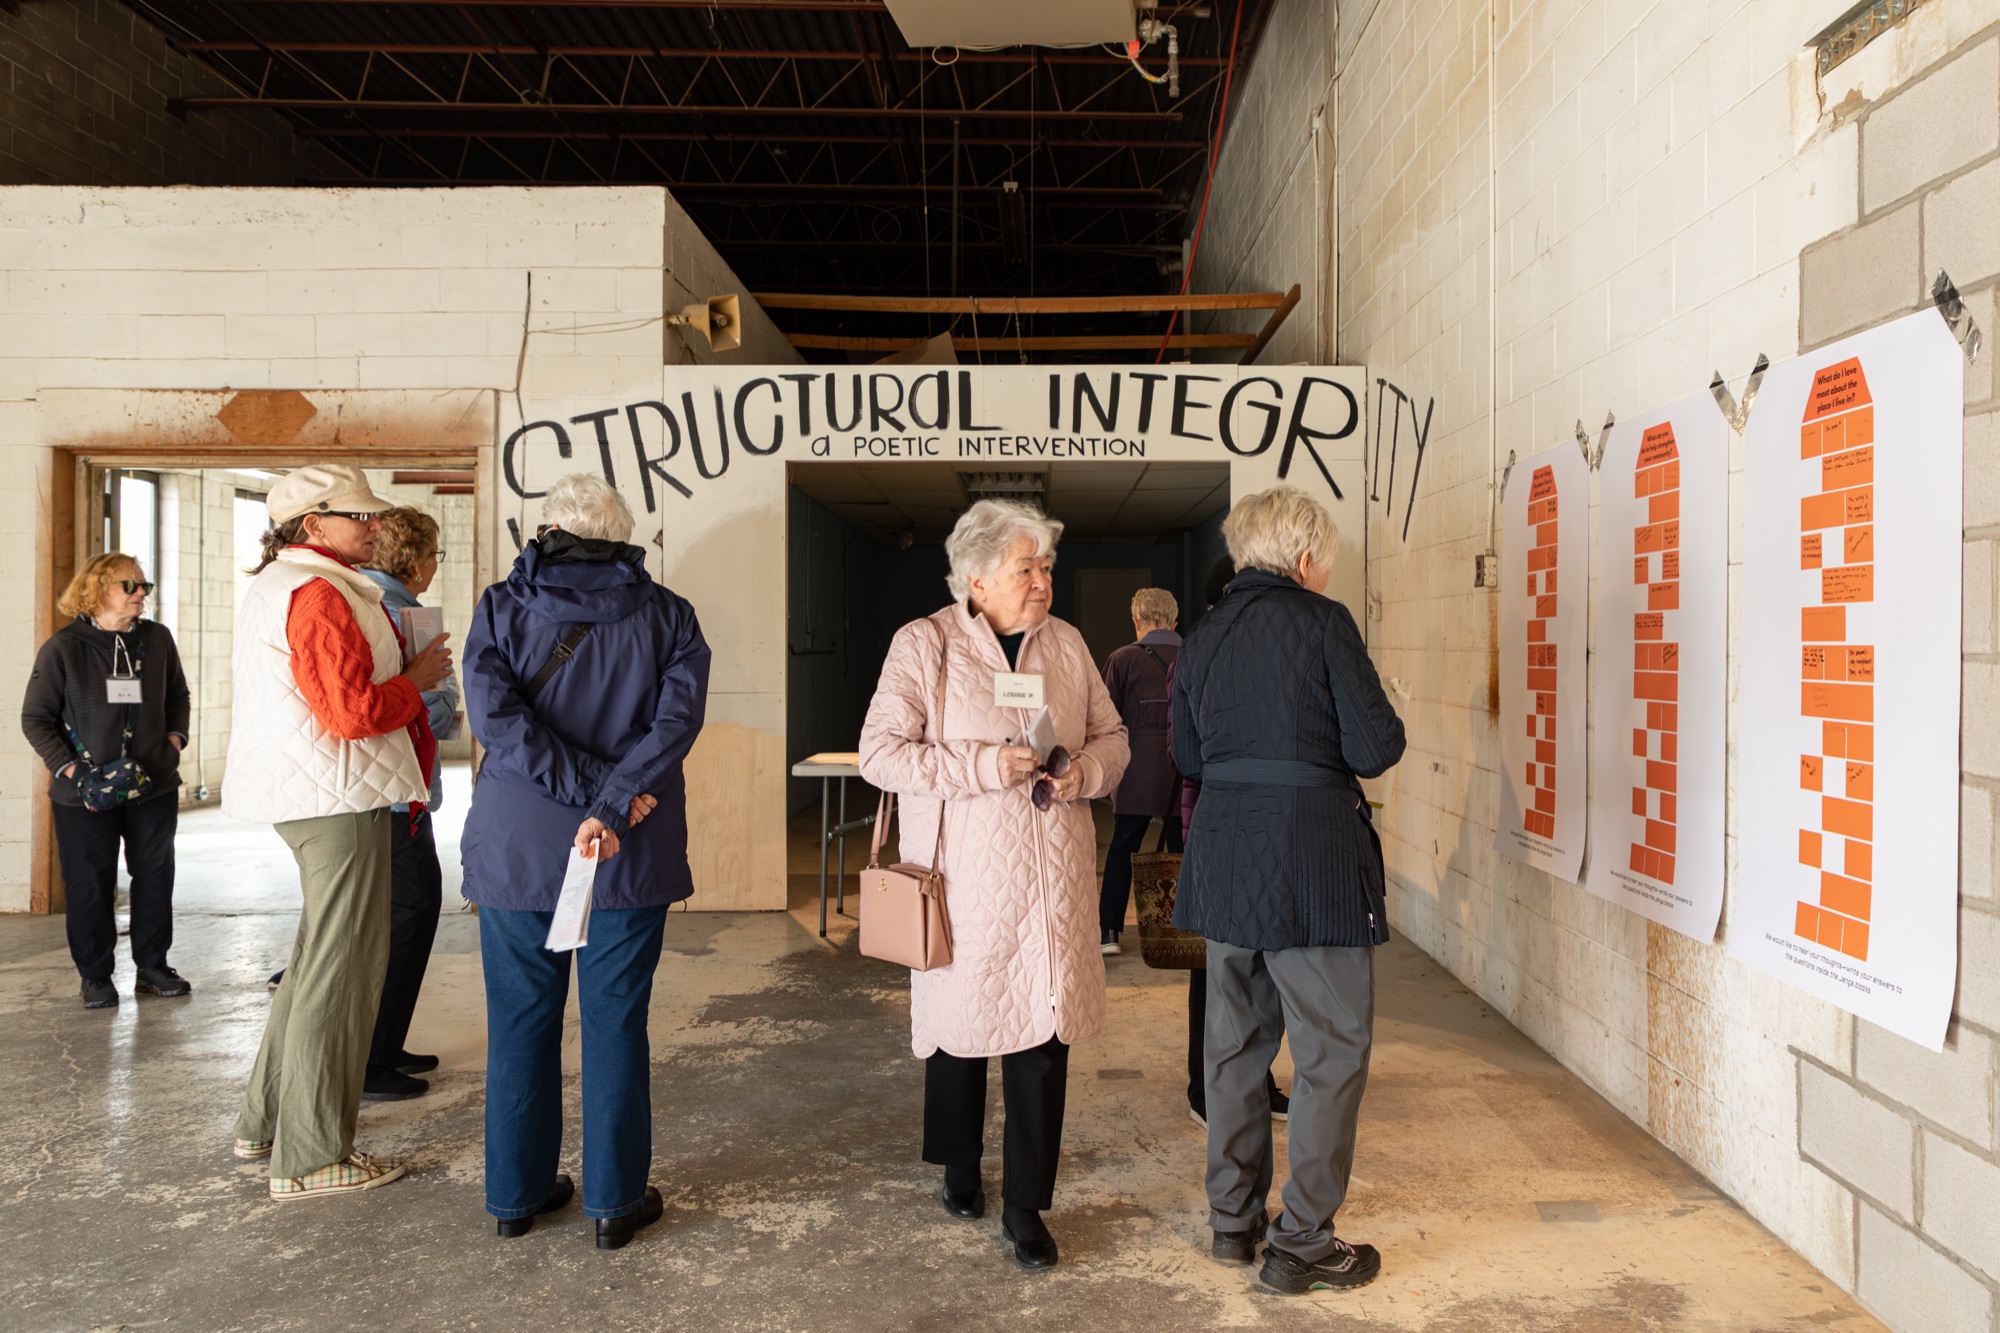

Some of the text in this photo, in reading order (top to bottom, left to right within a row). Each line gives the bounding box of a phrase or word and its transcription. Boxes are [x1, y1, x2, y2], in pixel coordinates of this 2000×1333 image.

[1817, 375, 1832, 386] What
[1833, 371, 1841, 380] do
[1844, 367, 1857, 376] love
[1816, 380, 1857, 400] most about the
[1817, 402, 1831, 415] place
[1835, 396, 1845, 406] live
[1846, 392, 1856, 403] in?
[853, 435, 941, 458] POETIC
[956, 434, 1146, 458] INTERVENTION
[1049, 371, 1434, 543] INTEGRITY
[1772, 936, 1784, 946] would
[1809, 950, 1821, 960] your
[1860, 972, 1872, 982] your
[1872, 976, 1895, 991] answers
[1896, 985, 1903, 995] to
[1785, 952, 1793, 961] the
[1793, 956, 1815, 970] questions
[1815, 965, 1829, 976] inside
[1829, 970, 1838, 980] the
[1854, 981, 1871, 994] blocks
